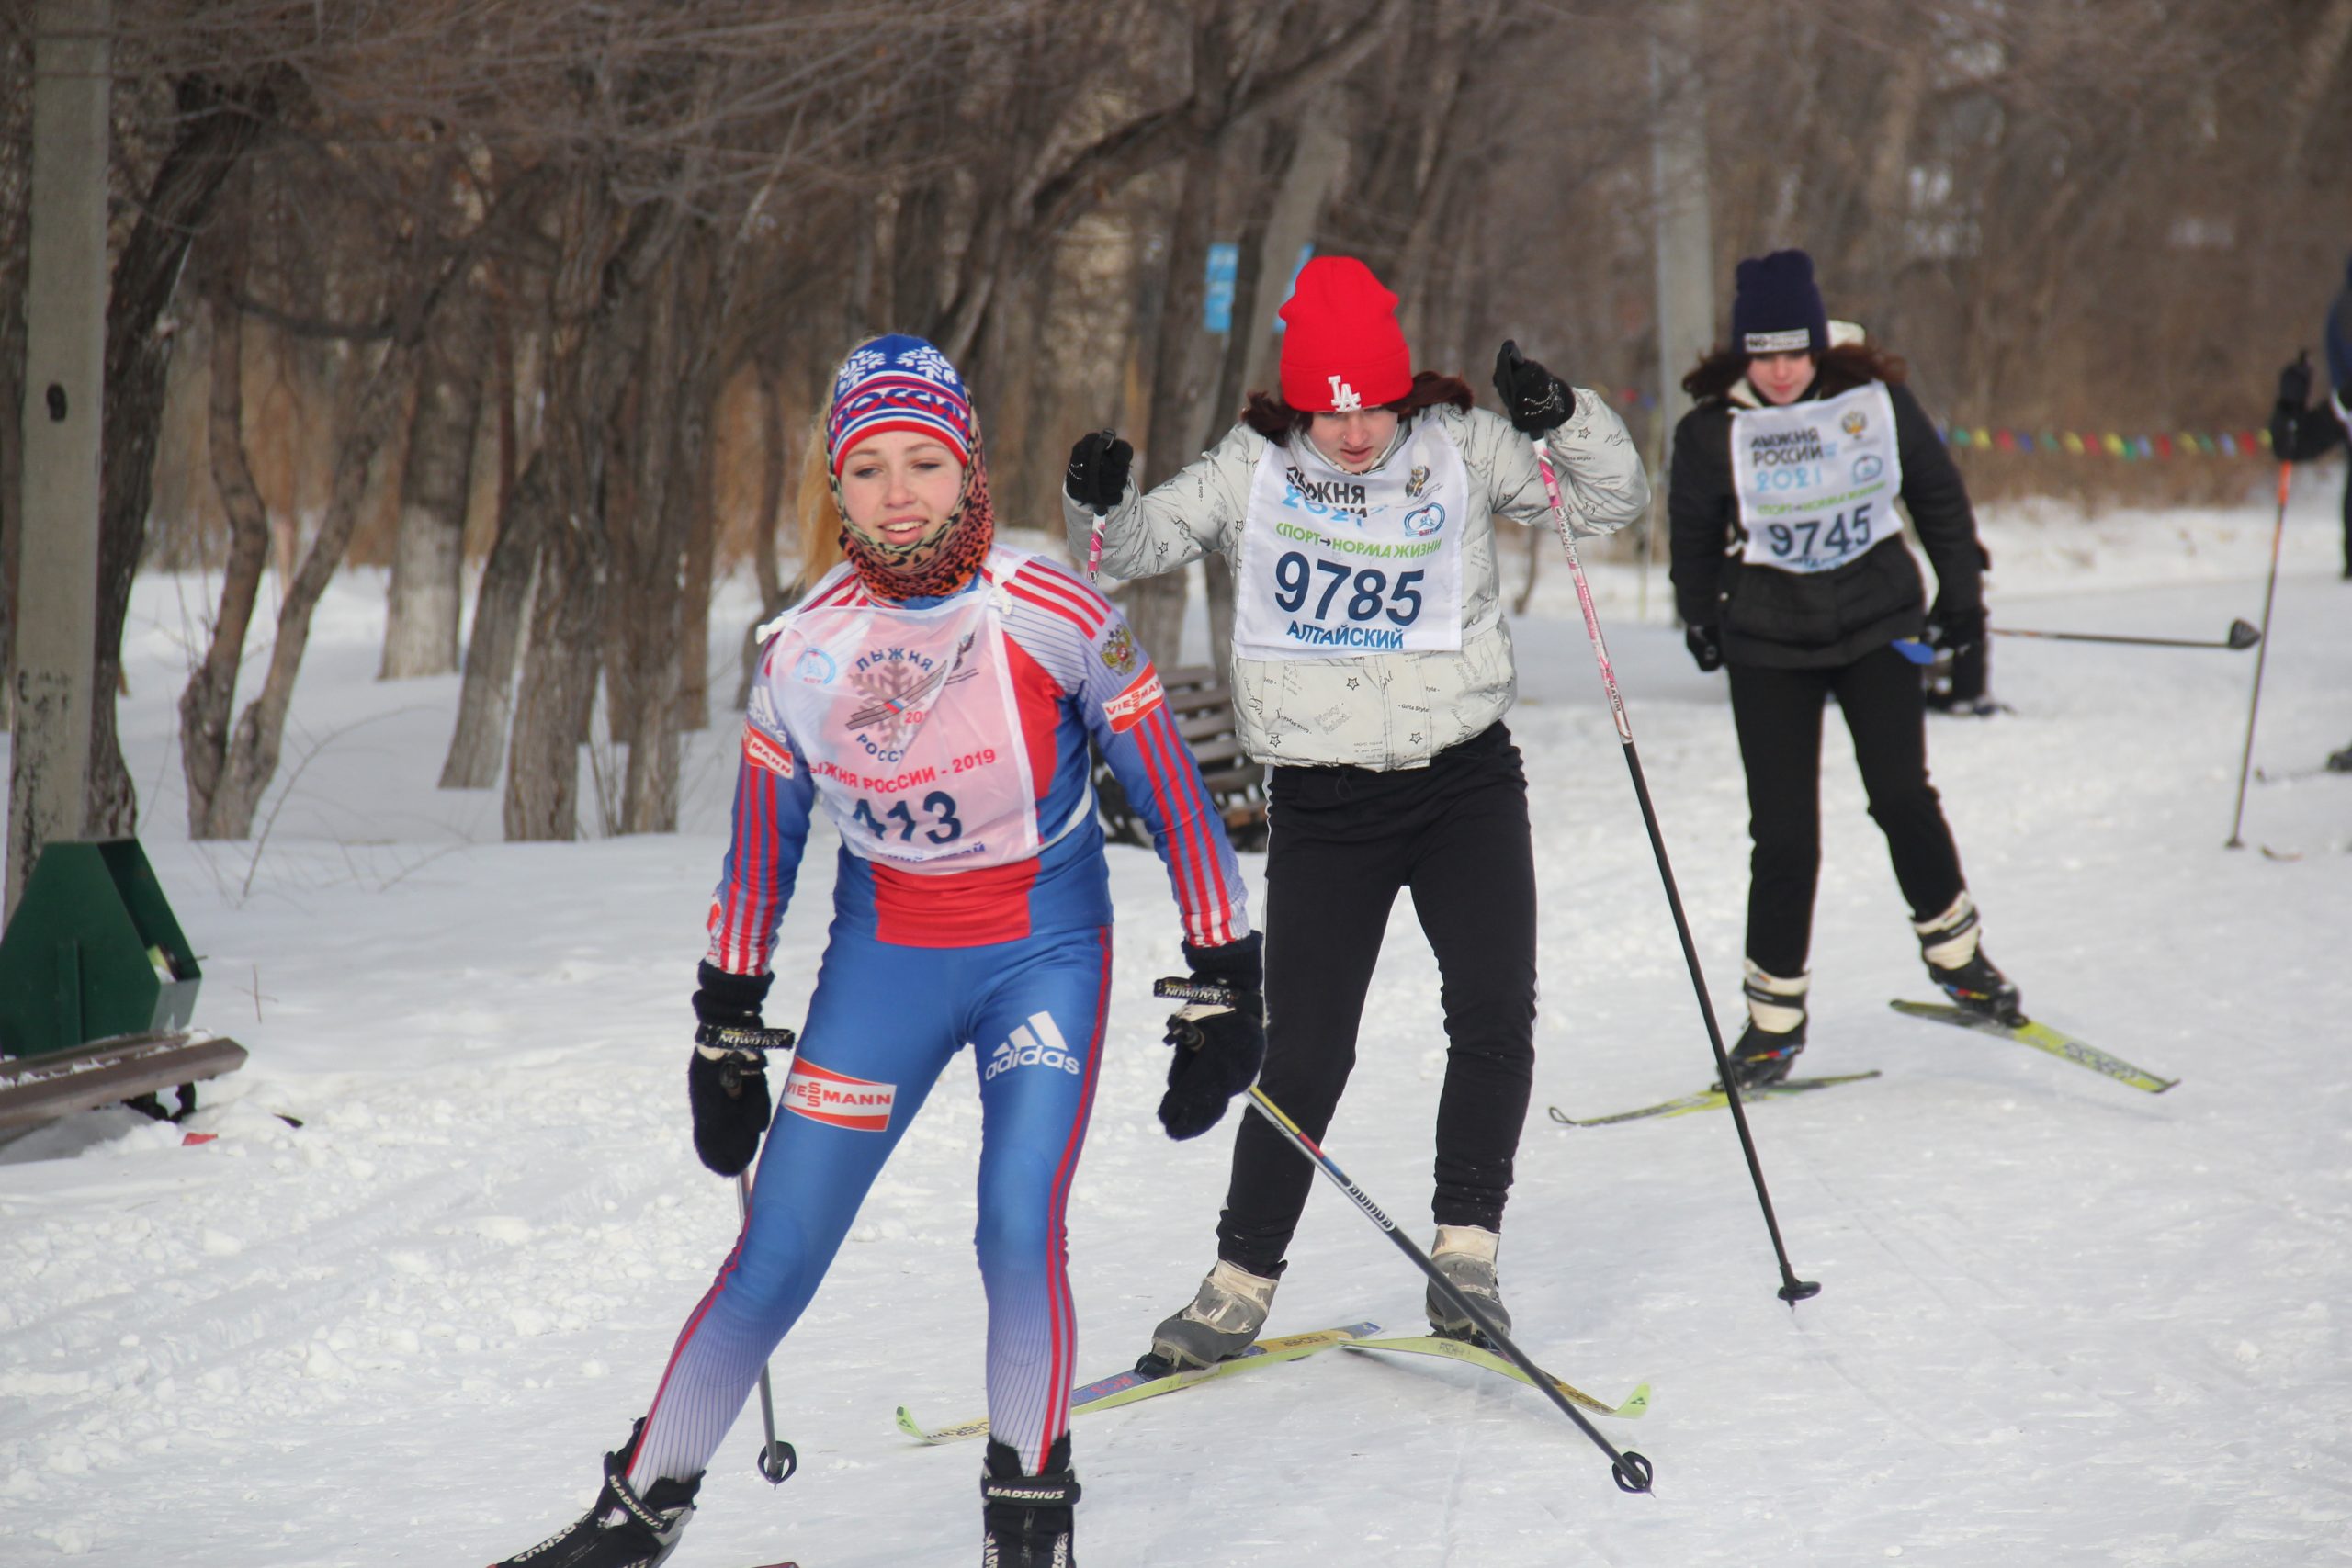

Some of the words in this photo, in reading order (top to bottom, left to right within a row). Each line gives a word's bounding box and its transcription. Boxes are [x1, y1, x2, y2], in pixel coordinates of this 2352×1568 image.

[1328, 375, 1360, 412] LA
[1756, 467, 1822, 492] 2021
[1276, 522, 1320, 545] СПОРТ
[1332, 537, 1391, 558] НОРМА
[1394, 539, 1442, 558] ЖИЗНИ
[1768, 503, 1872, 557] 9745
[1274, 551, 1424, 626] 9785
[1286, 620, 1404, 649] АЛТАЙСКИЙ
[855, 648, 933, 672] ЛЫЖНЯ
[808, 761, 859, 788] ЫЖНЯ
[863, 766, 936, 793] РОССИИ
[952, 749, 996, 773] 2019
[985, 1045, 1080, 1081] adidas
[987, 1486, 1065, 1500] MADSHUS
